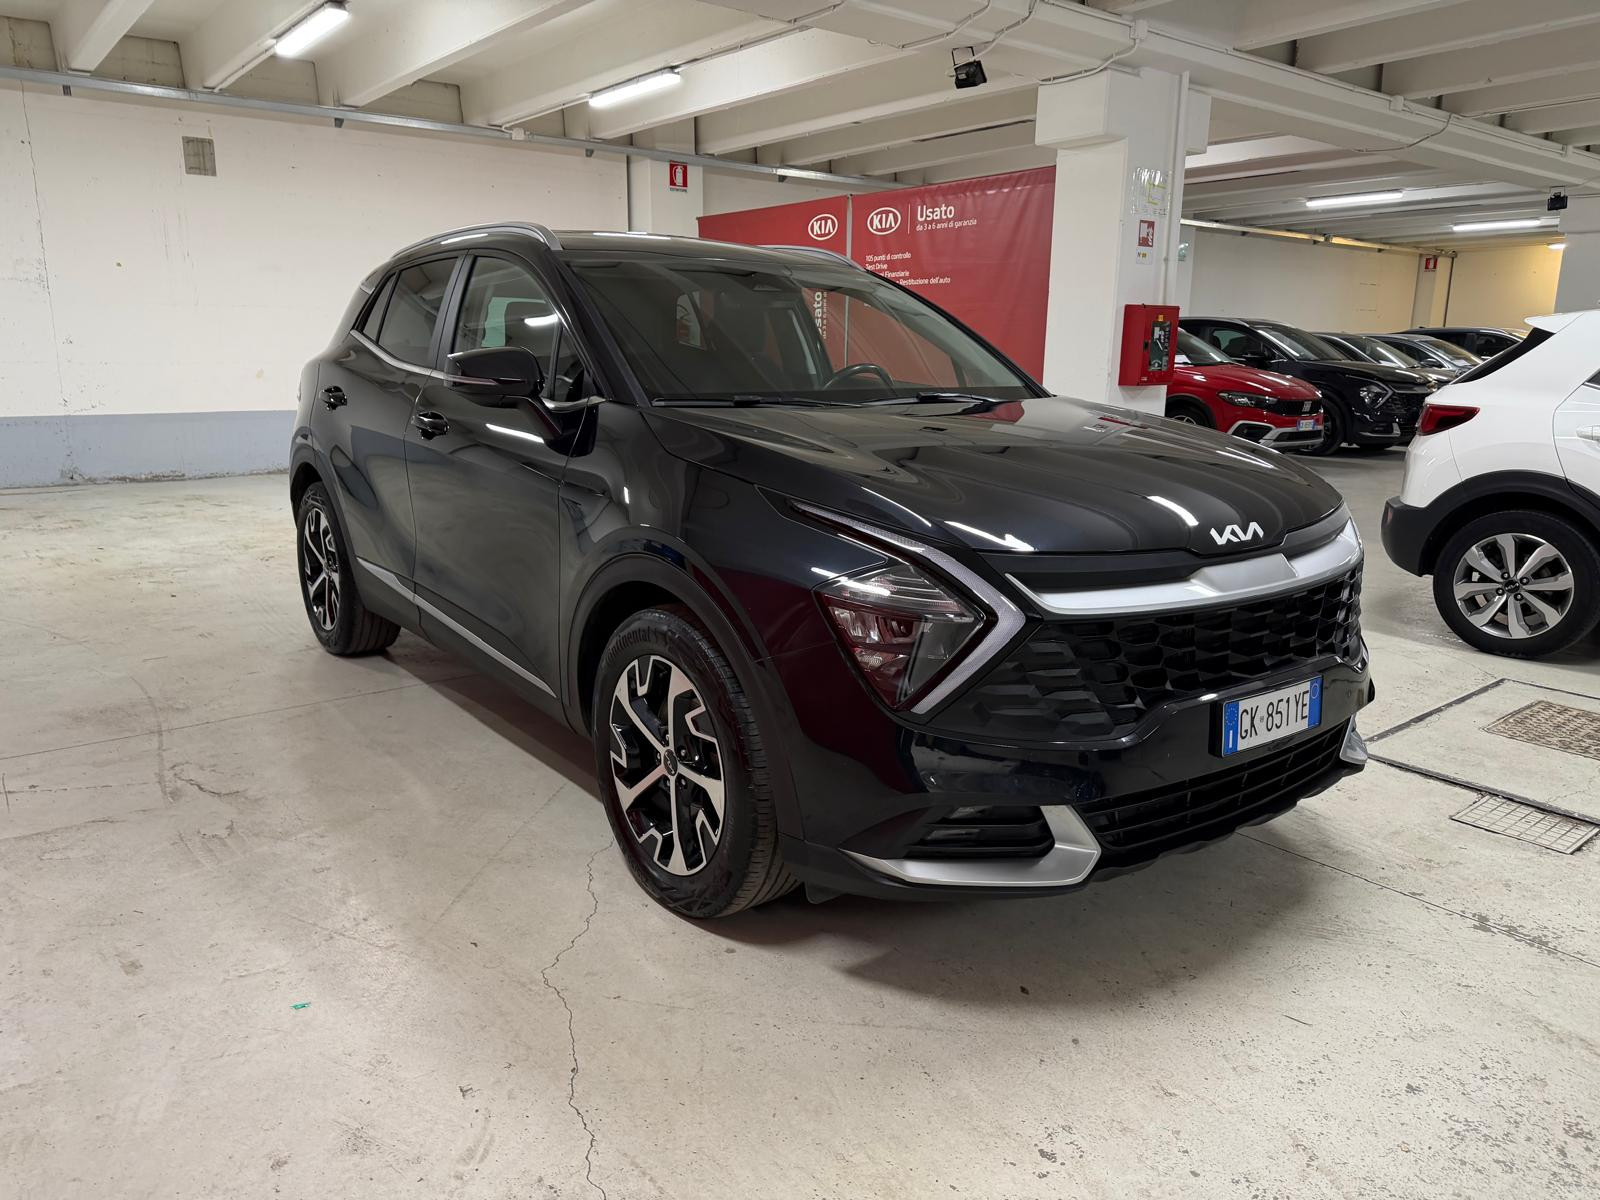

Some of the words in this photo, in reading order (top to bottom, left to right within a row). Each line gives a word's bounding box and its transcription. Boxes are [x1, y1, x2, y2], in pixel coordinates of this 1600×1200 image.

[917, 204, 955, 221] Usato
[936, 221, 948, 229] anni
[954, 218, 977, 229] garanzia
[1209, 521, 1264, 546] KIA
